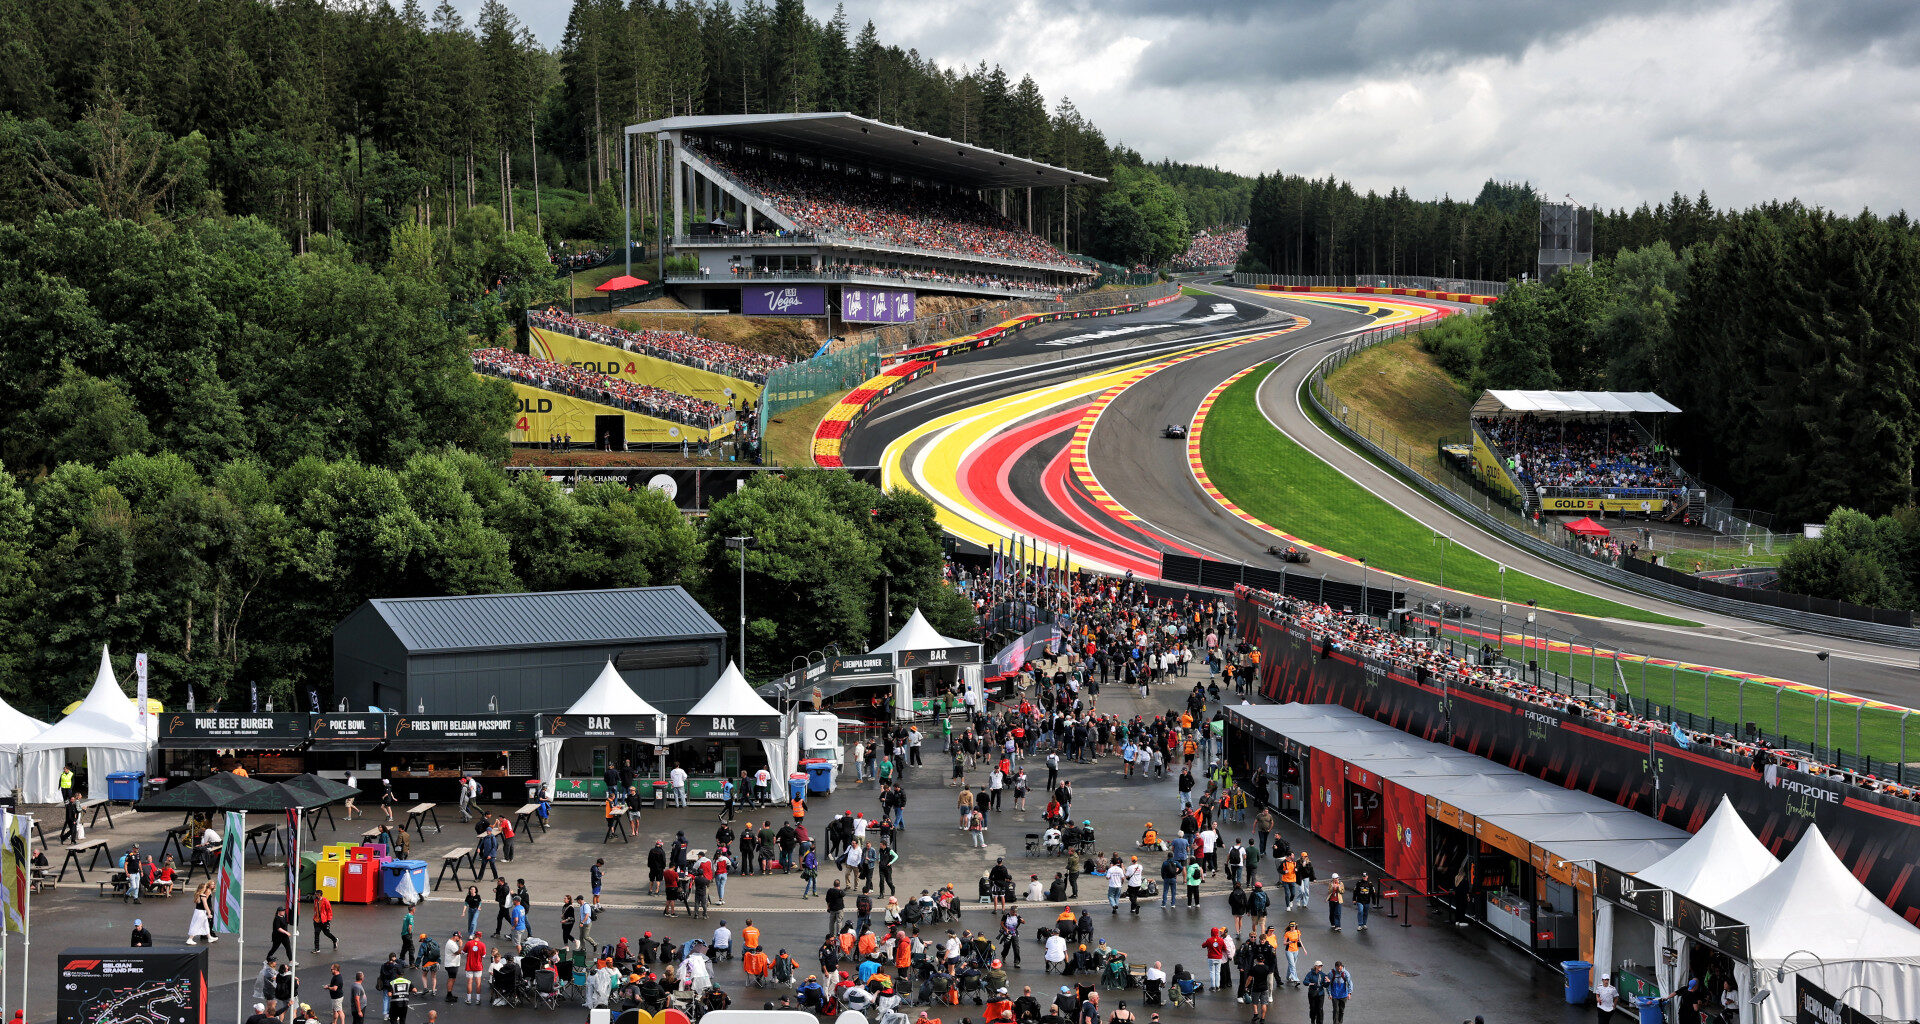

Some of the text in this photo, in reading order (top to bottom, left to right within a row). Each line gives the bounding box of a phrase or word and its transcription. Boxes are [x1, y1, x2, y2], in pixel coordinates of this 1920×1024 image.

[764, 289, 802, 312] Vegas
[624, 361, 637, 375] 4
[516, 398, 552, 413] OLD
[515, 416, 531, 431] 4
[1555, 500, 1594, 509] GOLD 5
[930, 649, 947, 661] BAR
[863, 659, 882, 668] CORNER
[1364, 662, 1386, 677] FANZONE
[195, 718, 274, 729] PURE BEEF BURGER
[329, 720, 366, 730] POKE BOWL
[411, 719, 512, 731] FRIES WITH BELGIAN PASSPORT
[588, 716, 611, 729] BAR
[712, 717, 735, 730] BAR
[1524, 710, 1558, 728] FANZONE
[1642, 760, 1649, 773] F
[1657, 758, 1664, 773] E
[1781, 778, 1839, 804] FANZONE
[1700, 908, 1717, 936] BAR
